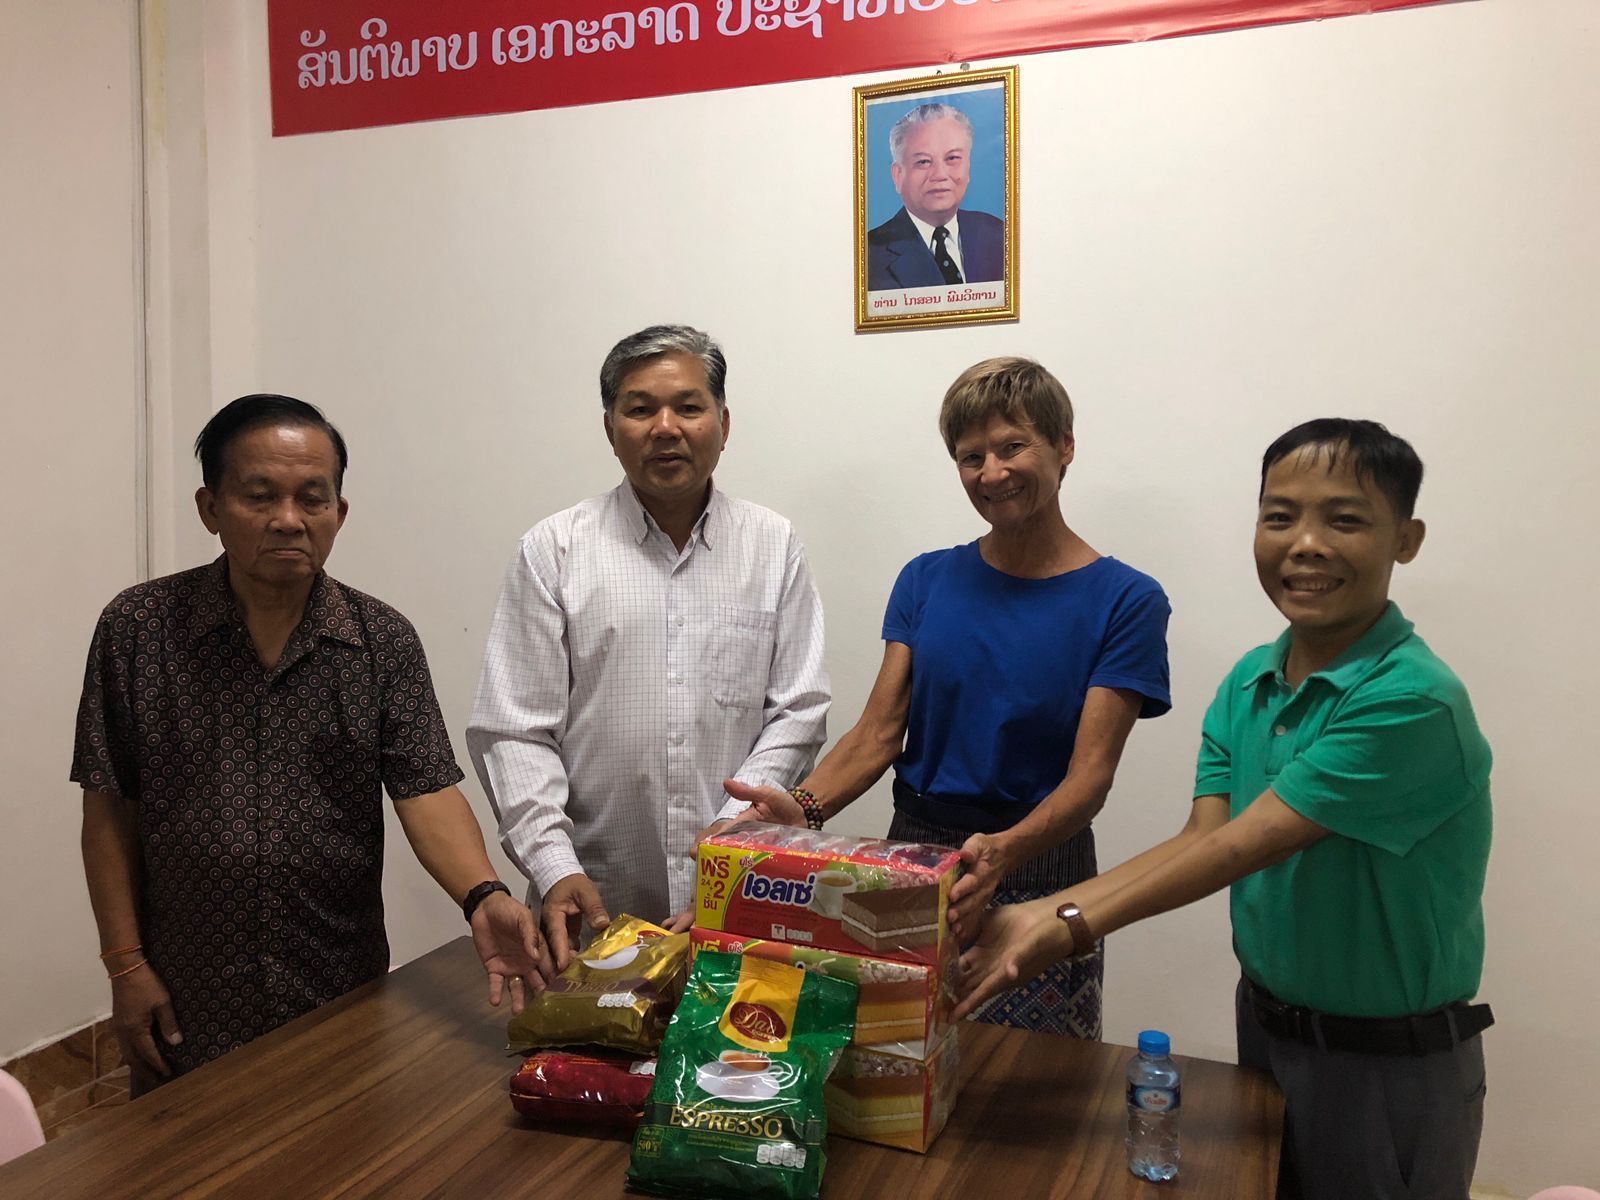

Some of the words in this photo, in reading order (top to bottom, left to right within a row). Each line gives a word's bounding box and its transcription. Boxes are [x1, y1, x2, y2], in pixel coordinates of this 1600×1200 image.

[297, 17, 478, 89] ສັນຕິພາບ
[491, 2, 700, 65] ເອກະລາດ
[700, 854, 731, 880] ฟรี
[743, 871, 816, 906] เอลเซ่
[734, 1003, 777, 1034] Dao
[669, 1105, 783, 1139] ESPRESSO
